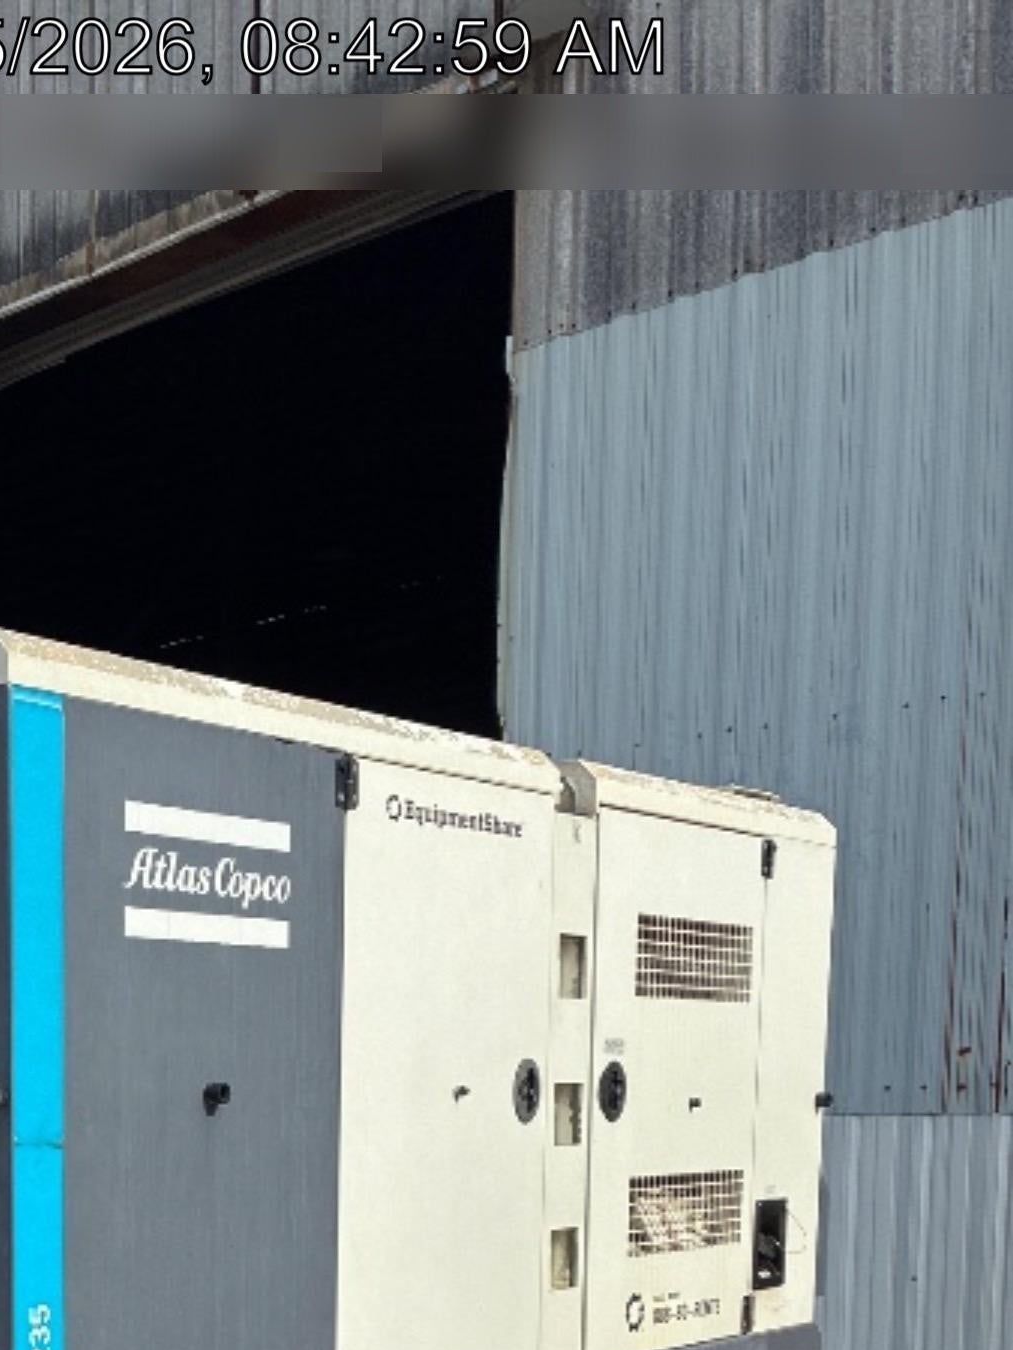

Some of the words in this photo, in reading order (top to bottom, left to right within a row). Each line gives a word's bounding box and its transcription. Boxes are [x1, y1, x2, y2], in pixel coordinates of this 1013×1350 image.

[404, 799, 522, 838] EquipmentShare
[123, 846, 212, 896] Atlas
[214, 857, 291, 909] Copco
